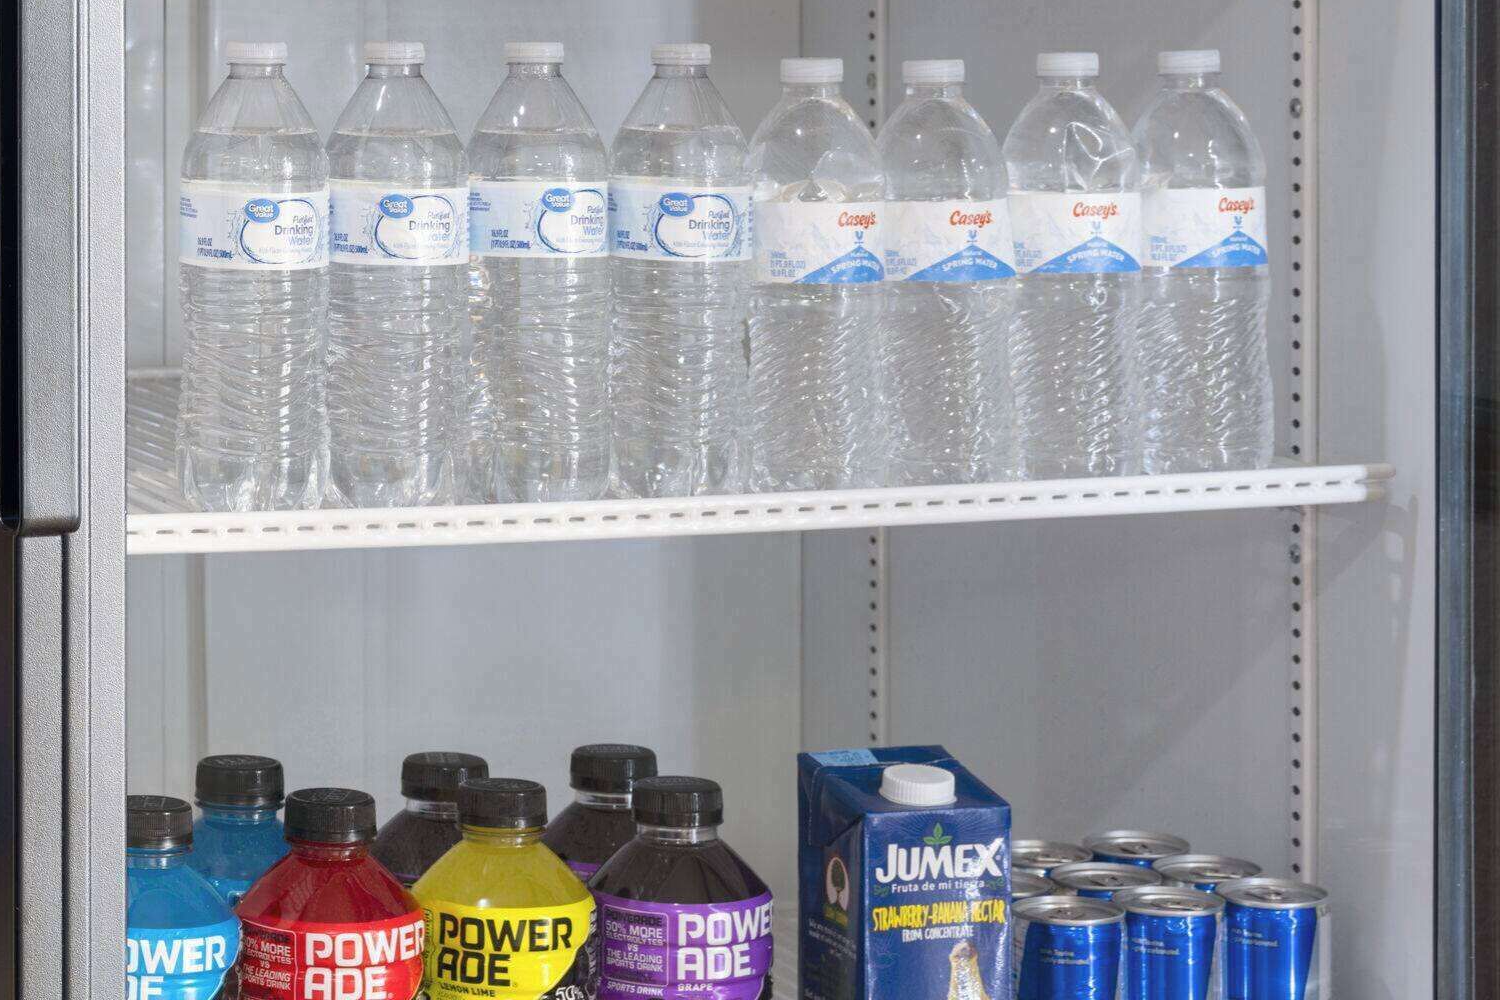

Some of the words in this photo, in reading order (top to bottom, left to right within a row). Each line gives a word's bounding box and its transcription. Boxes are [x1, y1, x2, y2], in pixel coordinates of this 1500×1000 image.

[1073, 201, 1119, 220] Casey's
[1218, 196, 1256, 214] Casey's
[408, 220, 451, 233] Drinking
[688, 219, 730, 231] Drinking
[838, 211, 877, 229] Casey's
[949, 210, 993, 229] Casey's
[274, 225, 314, 237] Drinking
[875, 837, 1005, 884] JUMEX
[891, 883, 919, 894] Fruta
[921, 881, 936, 891] de
[938, 880, 952, 890] mi
[439, 912, 573, 952] POWER
[605, 920, 628, 935] 50%
[629, 925, 663, 939] MORE
[902, 928, 923, 942] FROM
[924, 924, 975, 940] CONCENTRATE
[260, 941, 292, 957] MORE
[305, 919, 426, 967] POWER
[606, 948, 622, 959] THE
[622, 951, 663, 965] LEADING
[606, 957, 635, 969] SPORTS
[636, 961, 664, 973] DRINK
[677, 942, 752, 980] ADE
[255, 966, 292, 983] LEADING
[437, 947, 511, 987] ADE
[266, 979, 292, 991] DRINK
[304, 965, 388, 1000] ADE
[440, 981, 469, 996] LEMON
[471, 987, 497, 998] LIME
[606, 980, 636, 994] SPORTS
[636, 985, 664, 997] DRINK
[677, 983, 714, 992] GRAPE
